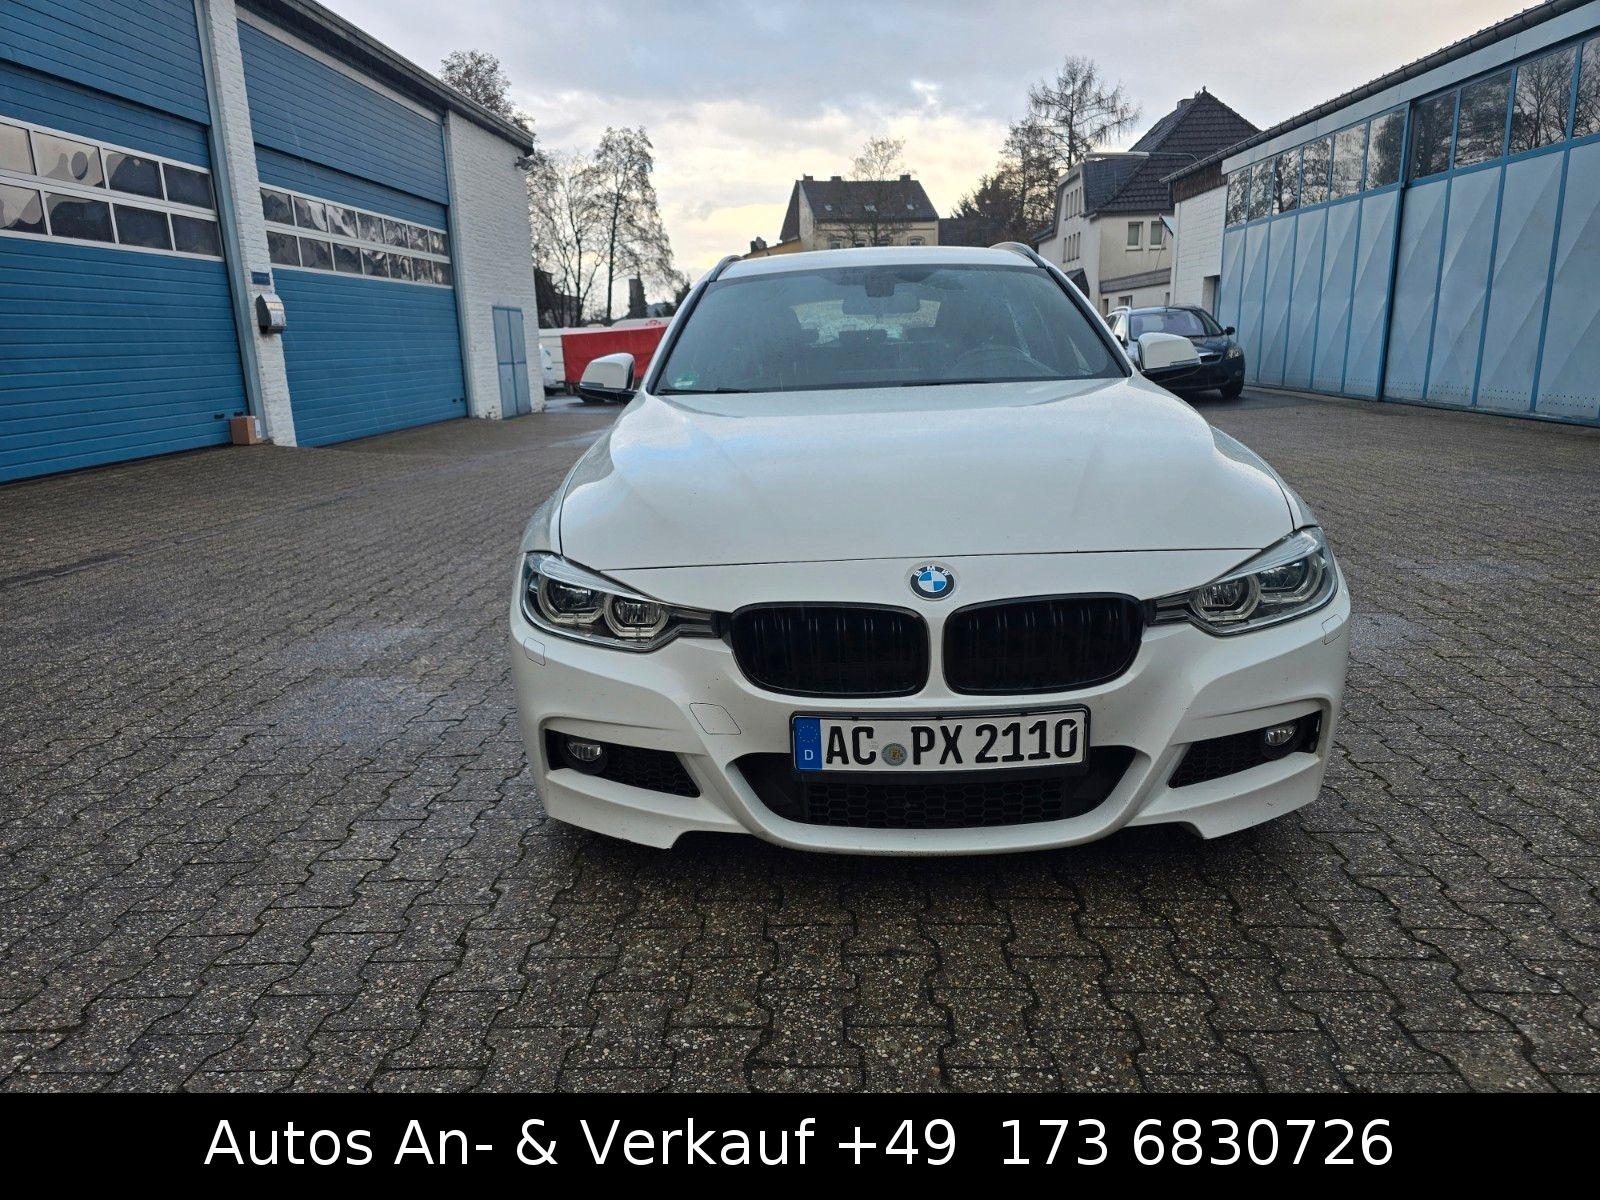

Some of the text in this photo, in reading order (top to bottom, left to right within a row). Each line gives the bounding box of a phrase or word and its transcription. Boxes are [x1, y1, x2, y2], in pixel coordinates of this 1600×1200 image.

[913, 565, 951, 577] BMW
[826, 726, 877, 765] AC
[911, 724, 963, 765] PX
[975, 719, 1078, 763] 2110
[804, 749, 814, 761] D
